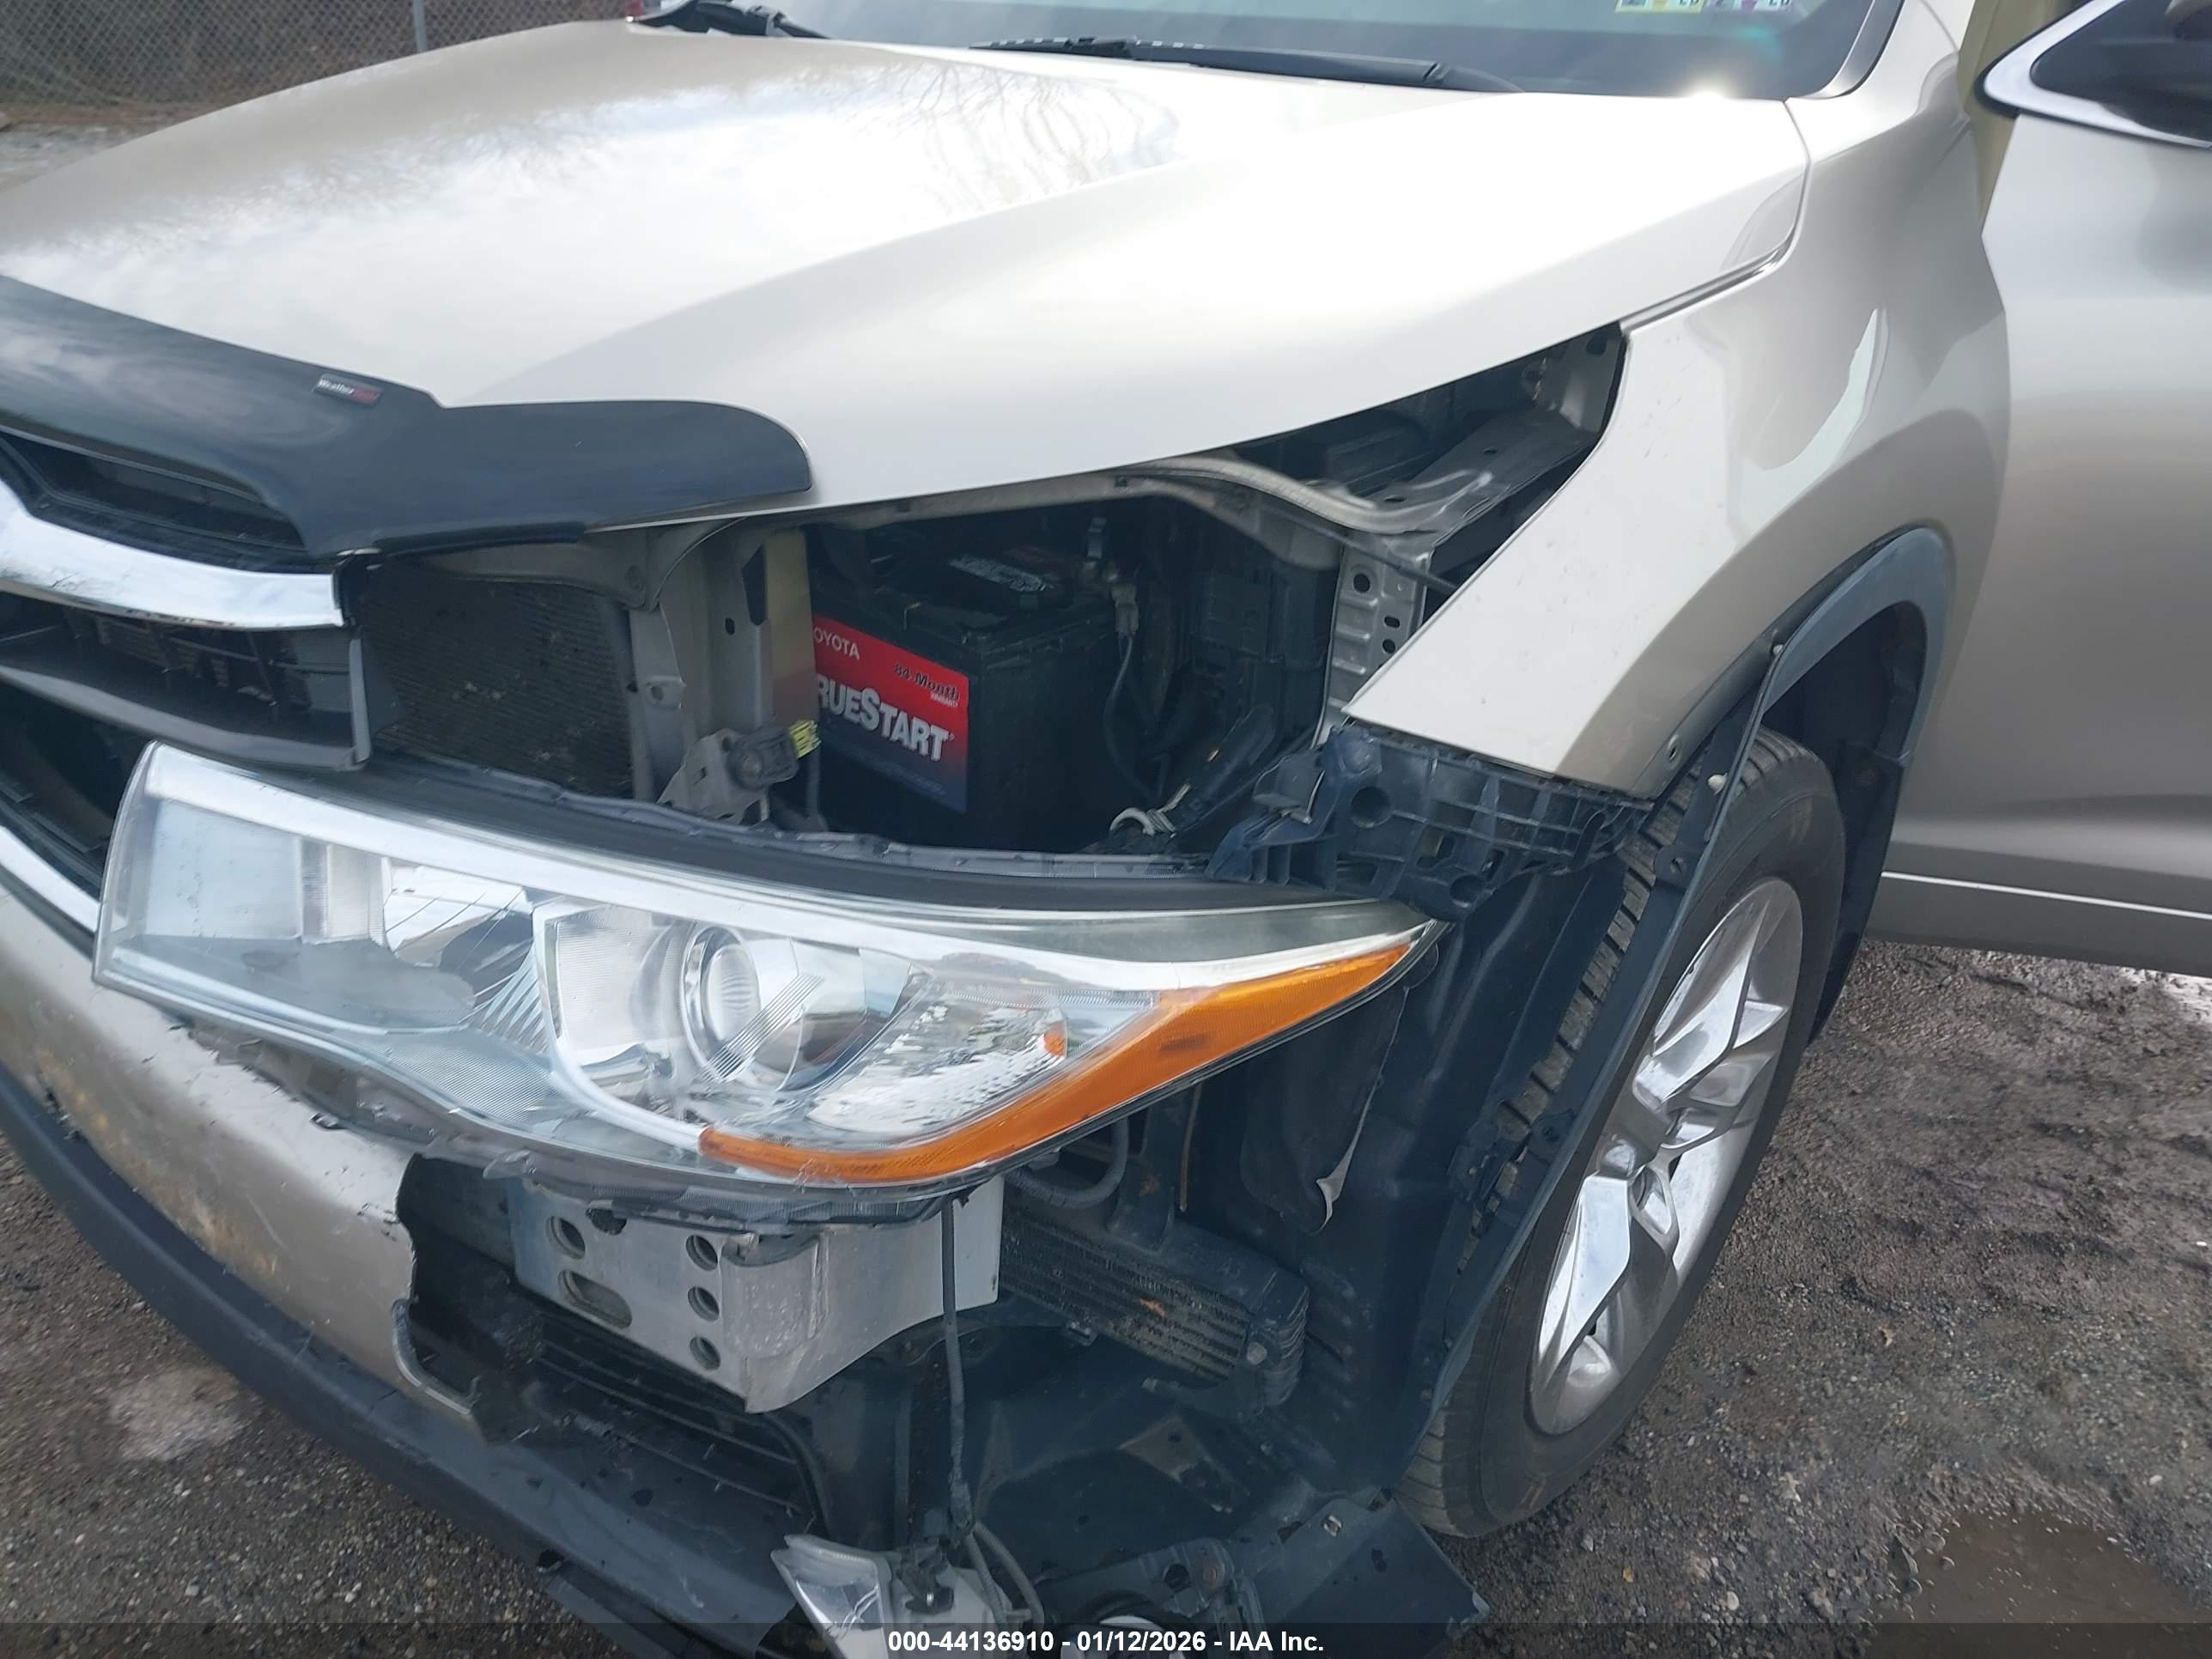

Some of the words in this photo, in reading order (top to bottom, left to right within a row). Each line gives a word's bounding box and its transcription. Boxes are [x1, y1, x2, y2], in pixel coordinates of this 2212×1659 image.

[813, 626, 860, 660] OYOTA
[914, 672, 960, 702] Month
[816, 673, 950, 763] RUESTART
